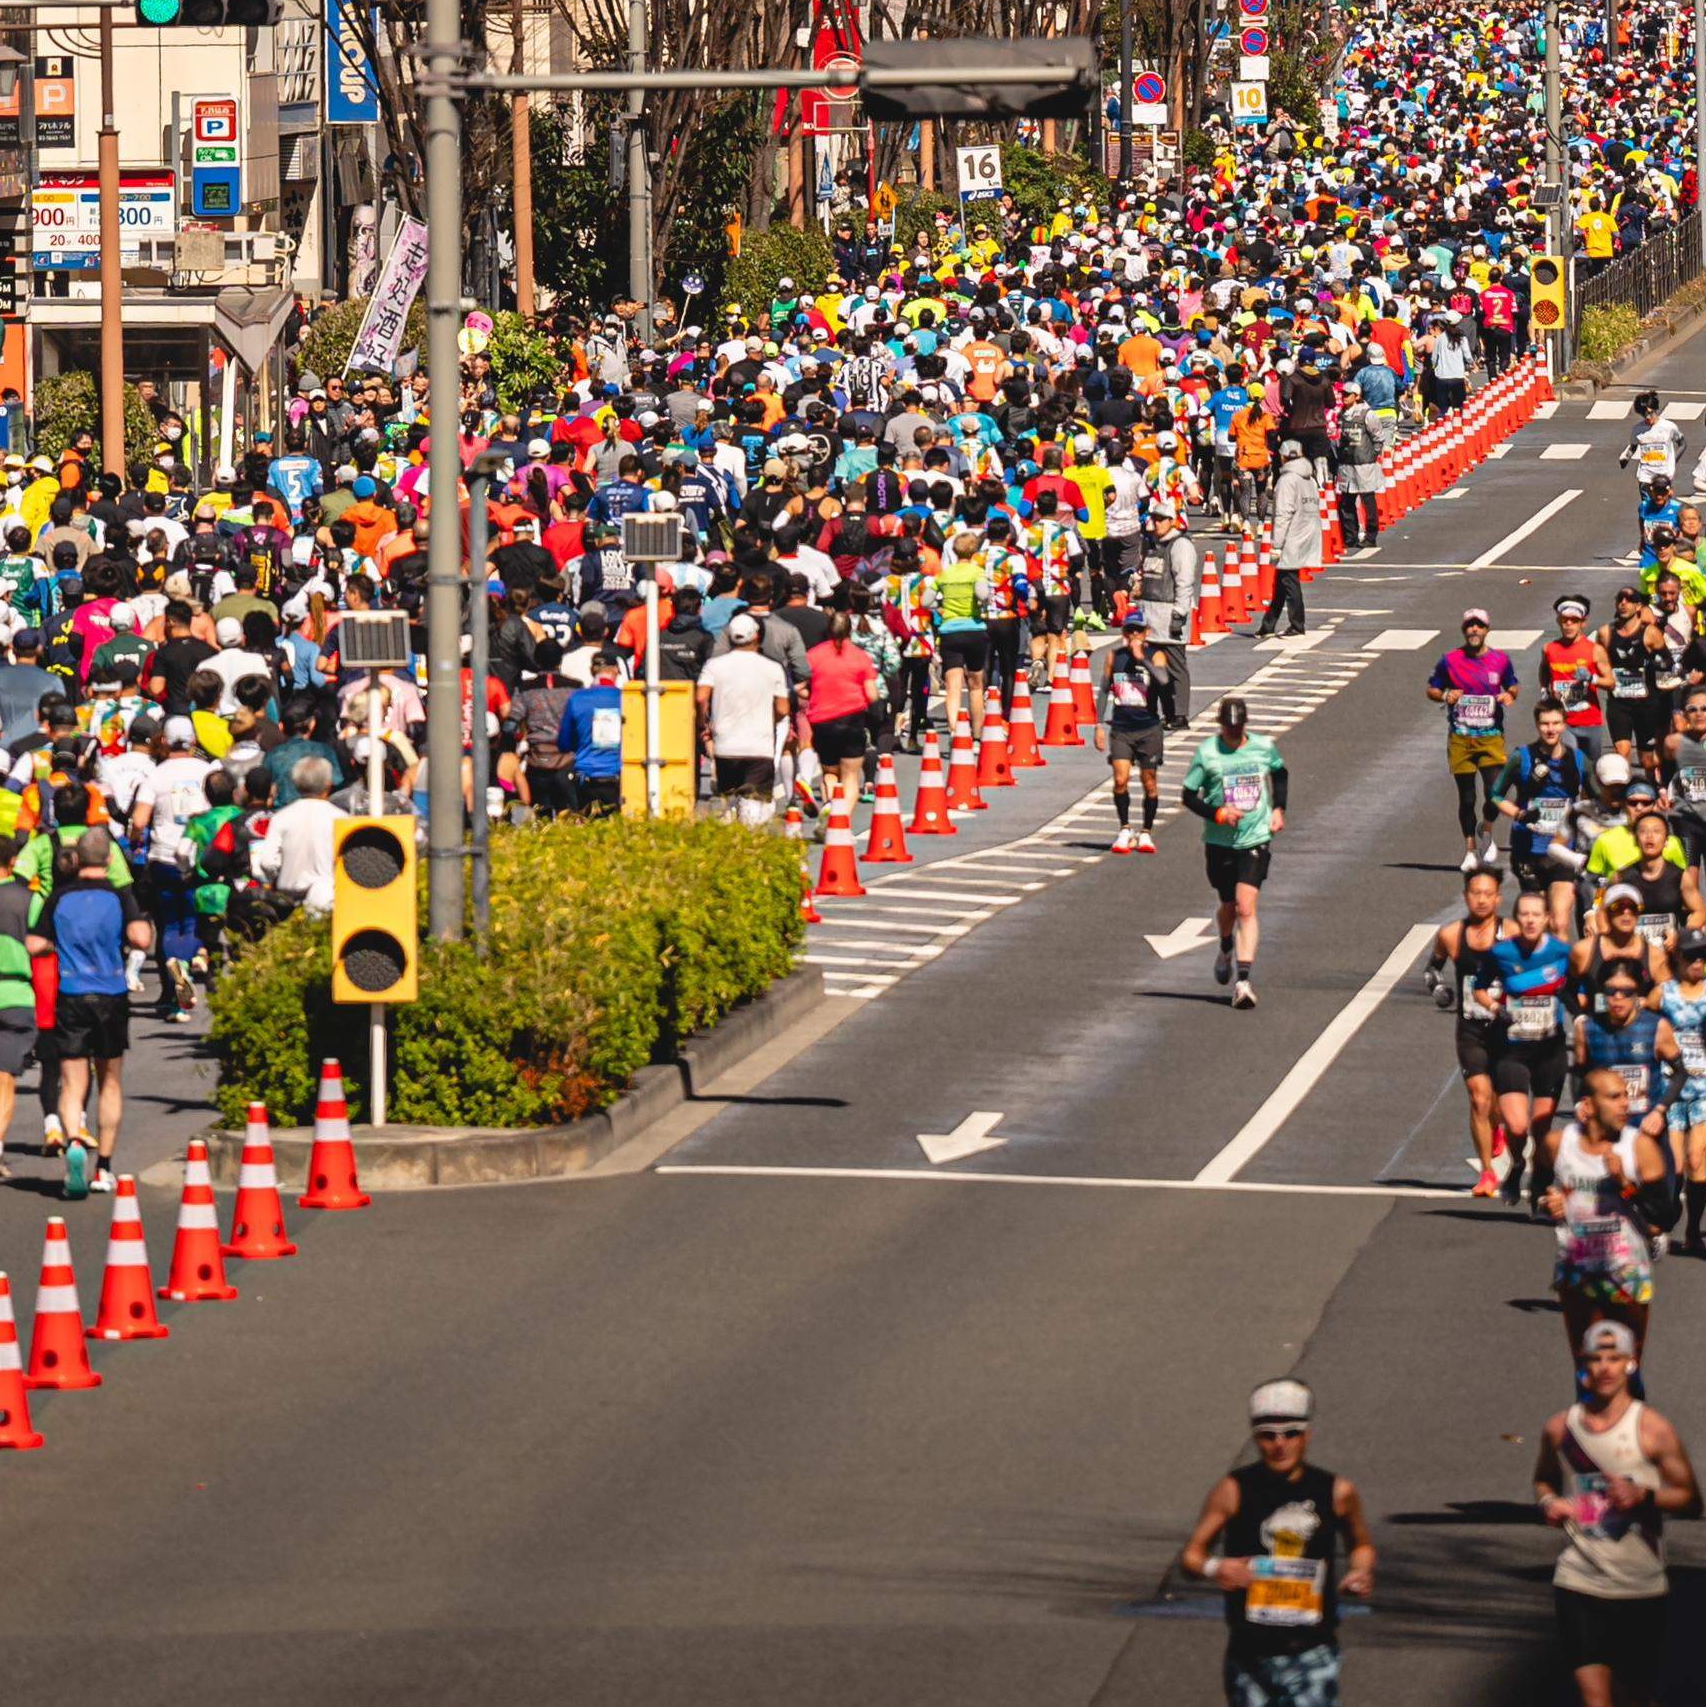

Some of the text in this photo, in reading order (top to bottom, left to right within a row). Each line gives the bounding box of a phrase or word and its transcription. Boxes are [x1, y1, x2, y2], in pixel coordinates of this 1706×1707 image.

[339, 3, 366, 104] GROUP
[44, 85, 66, 110] P
[1238, 89, 1261, 108] 10
[207, 121, 223, 133] P
[964, 153, 996, 179] 16
[50, 235, 65, 246] 20
[78, 235, 101, 246] 400
[287, 472, 302, 496] 5
[877, 474, 887, 510] NOCTA
